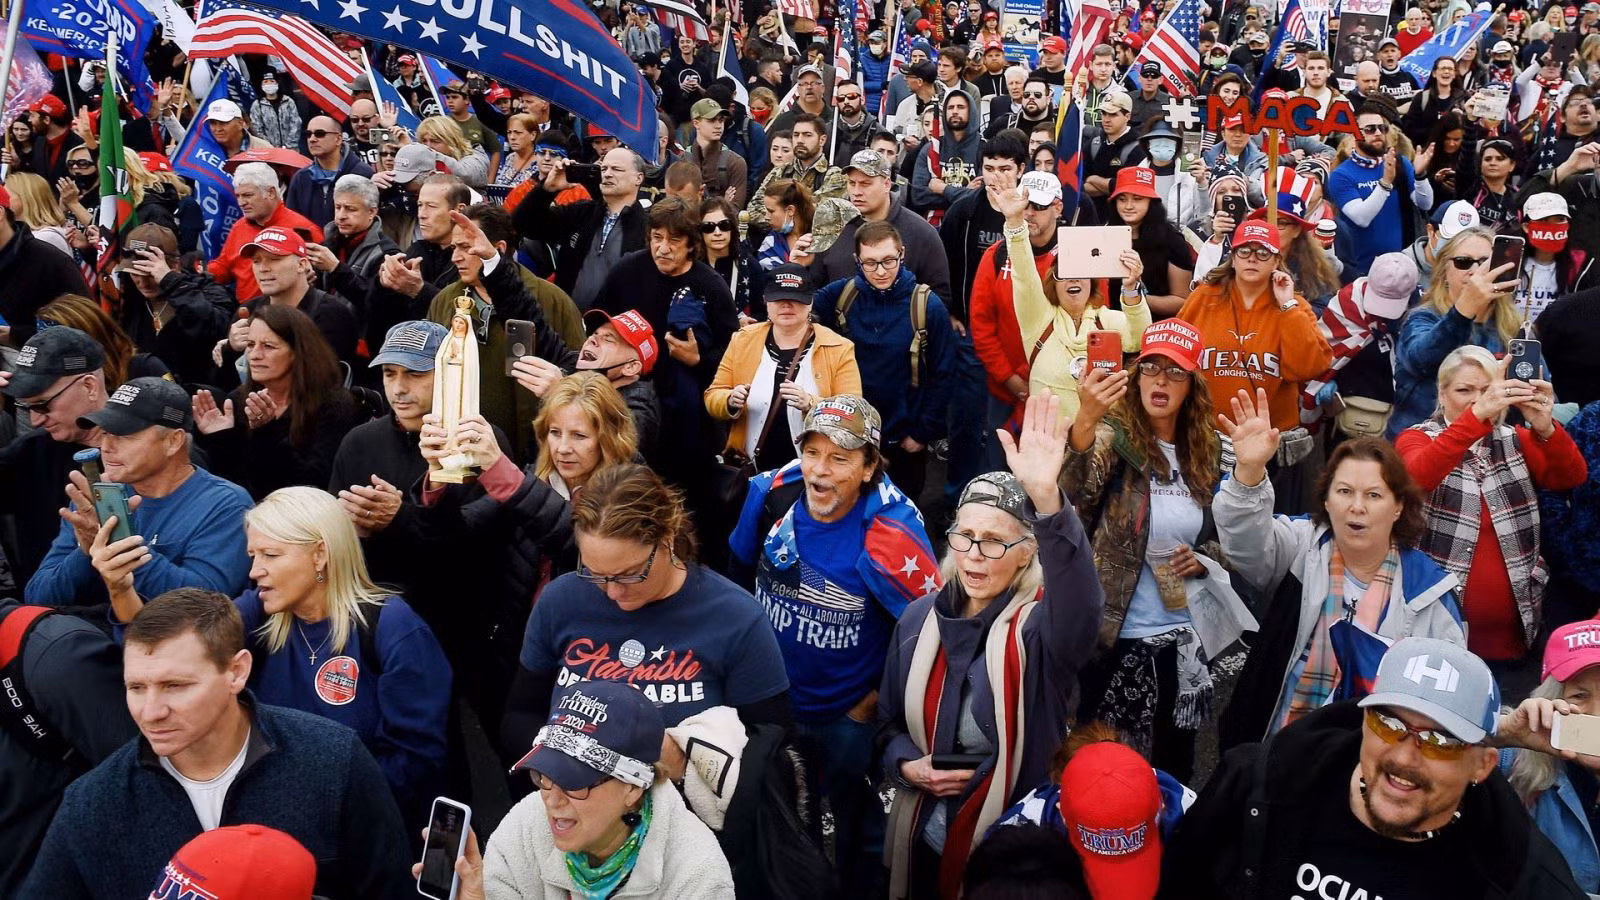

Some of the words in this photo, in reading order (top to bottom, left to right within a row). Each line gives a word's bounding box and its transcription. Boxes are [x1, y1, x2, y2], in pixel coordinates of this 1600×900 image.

[411, 0, 626, 100] ULLSHIT
[1146, 333, 1169, 345] GREAT
[1168, 334, 1194, 351] AGAIN
[1164, 321, 1199, 342] AMERICA
[1201, 347, 1280, 377] TEXAS
[816, 401, 855, 415] Trump
[800, 605, 812, 620] ALL
[814, 608, 849, 625] ABOARD
[796, 614, 861, 649] TRAIN
[558, 696, 608, 726] Trump
[571, 690, 608, 712] President
[562, 714, 585, 730] 2020
[1077, 826, 1147, 850] TRUMP
